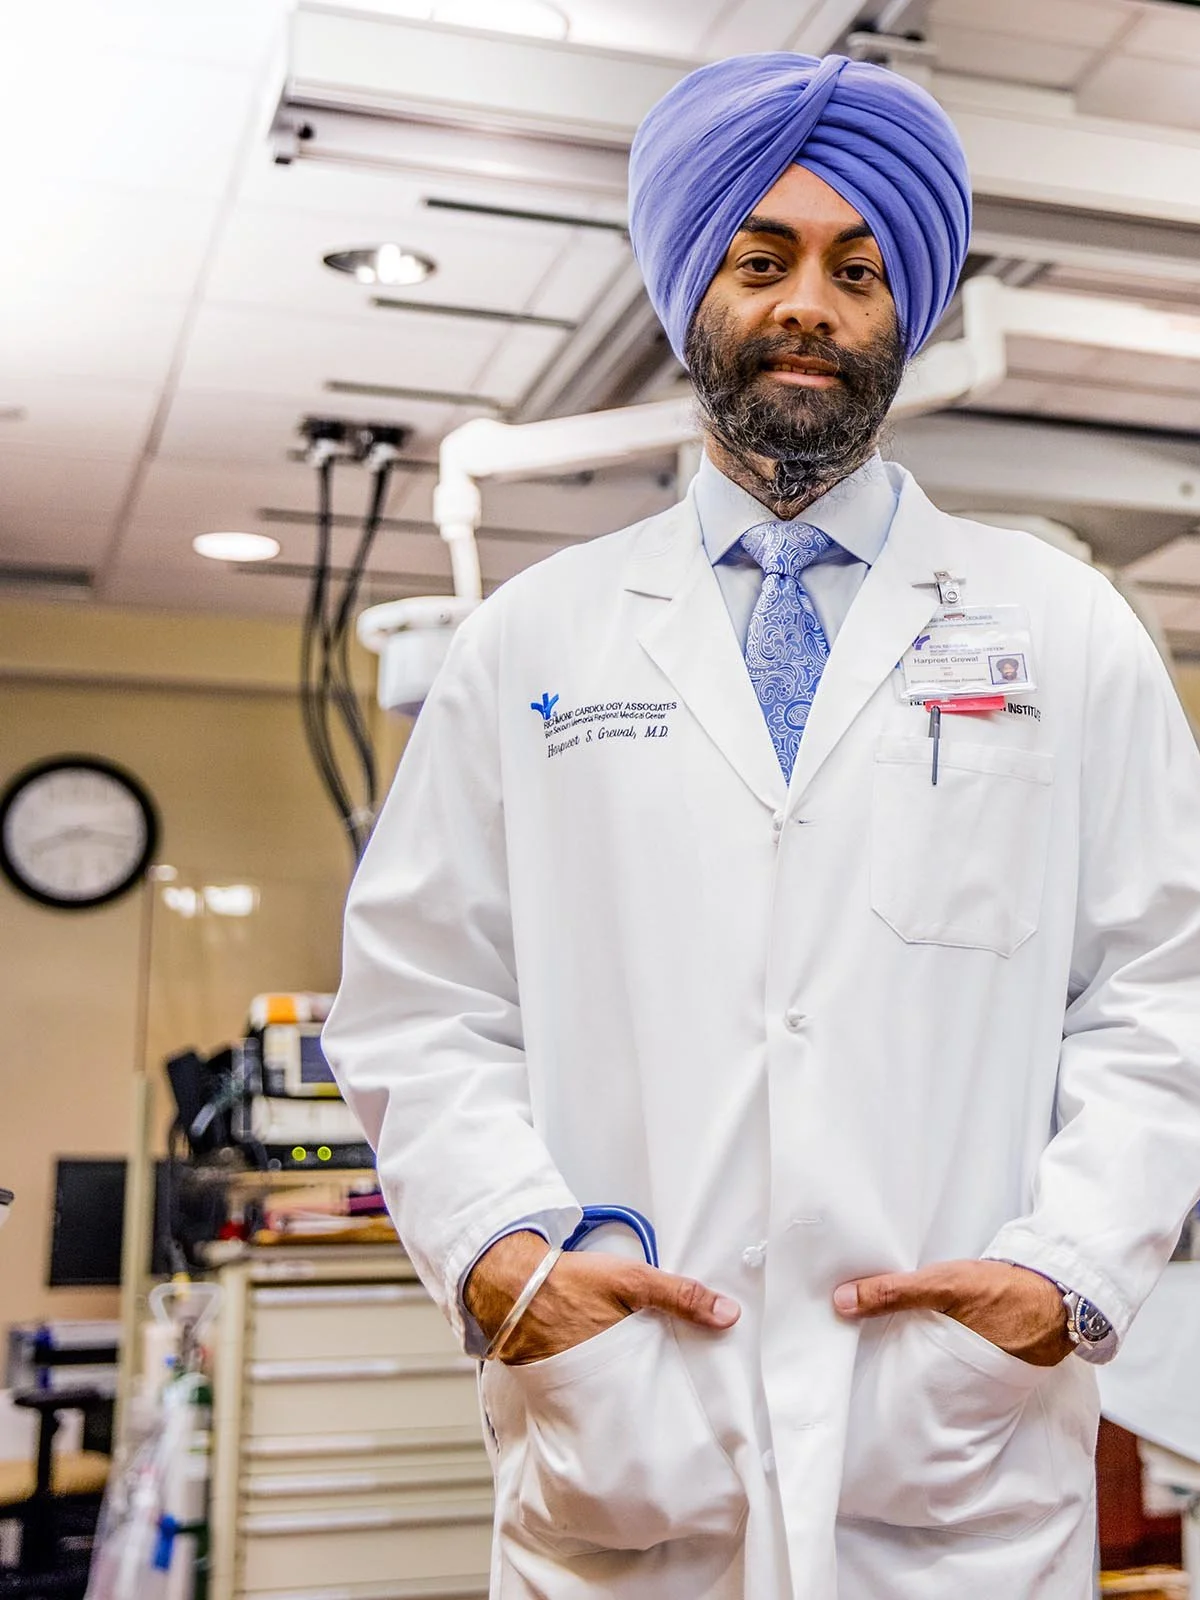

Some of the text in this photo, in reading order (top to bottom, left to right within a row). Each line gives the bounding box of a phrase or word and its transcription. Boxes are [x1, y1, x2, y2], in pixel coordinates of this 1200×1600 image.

[913, 657, 949, 665] Harpreet
[575, 702, 623, 718] CARDIOLOGY
[624, 701, 677, 712] ASSOCIATES
[619, 710, 645, 720] Medical
[645, 711, 666, 721] Center
